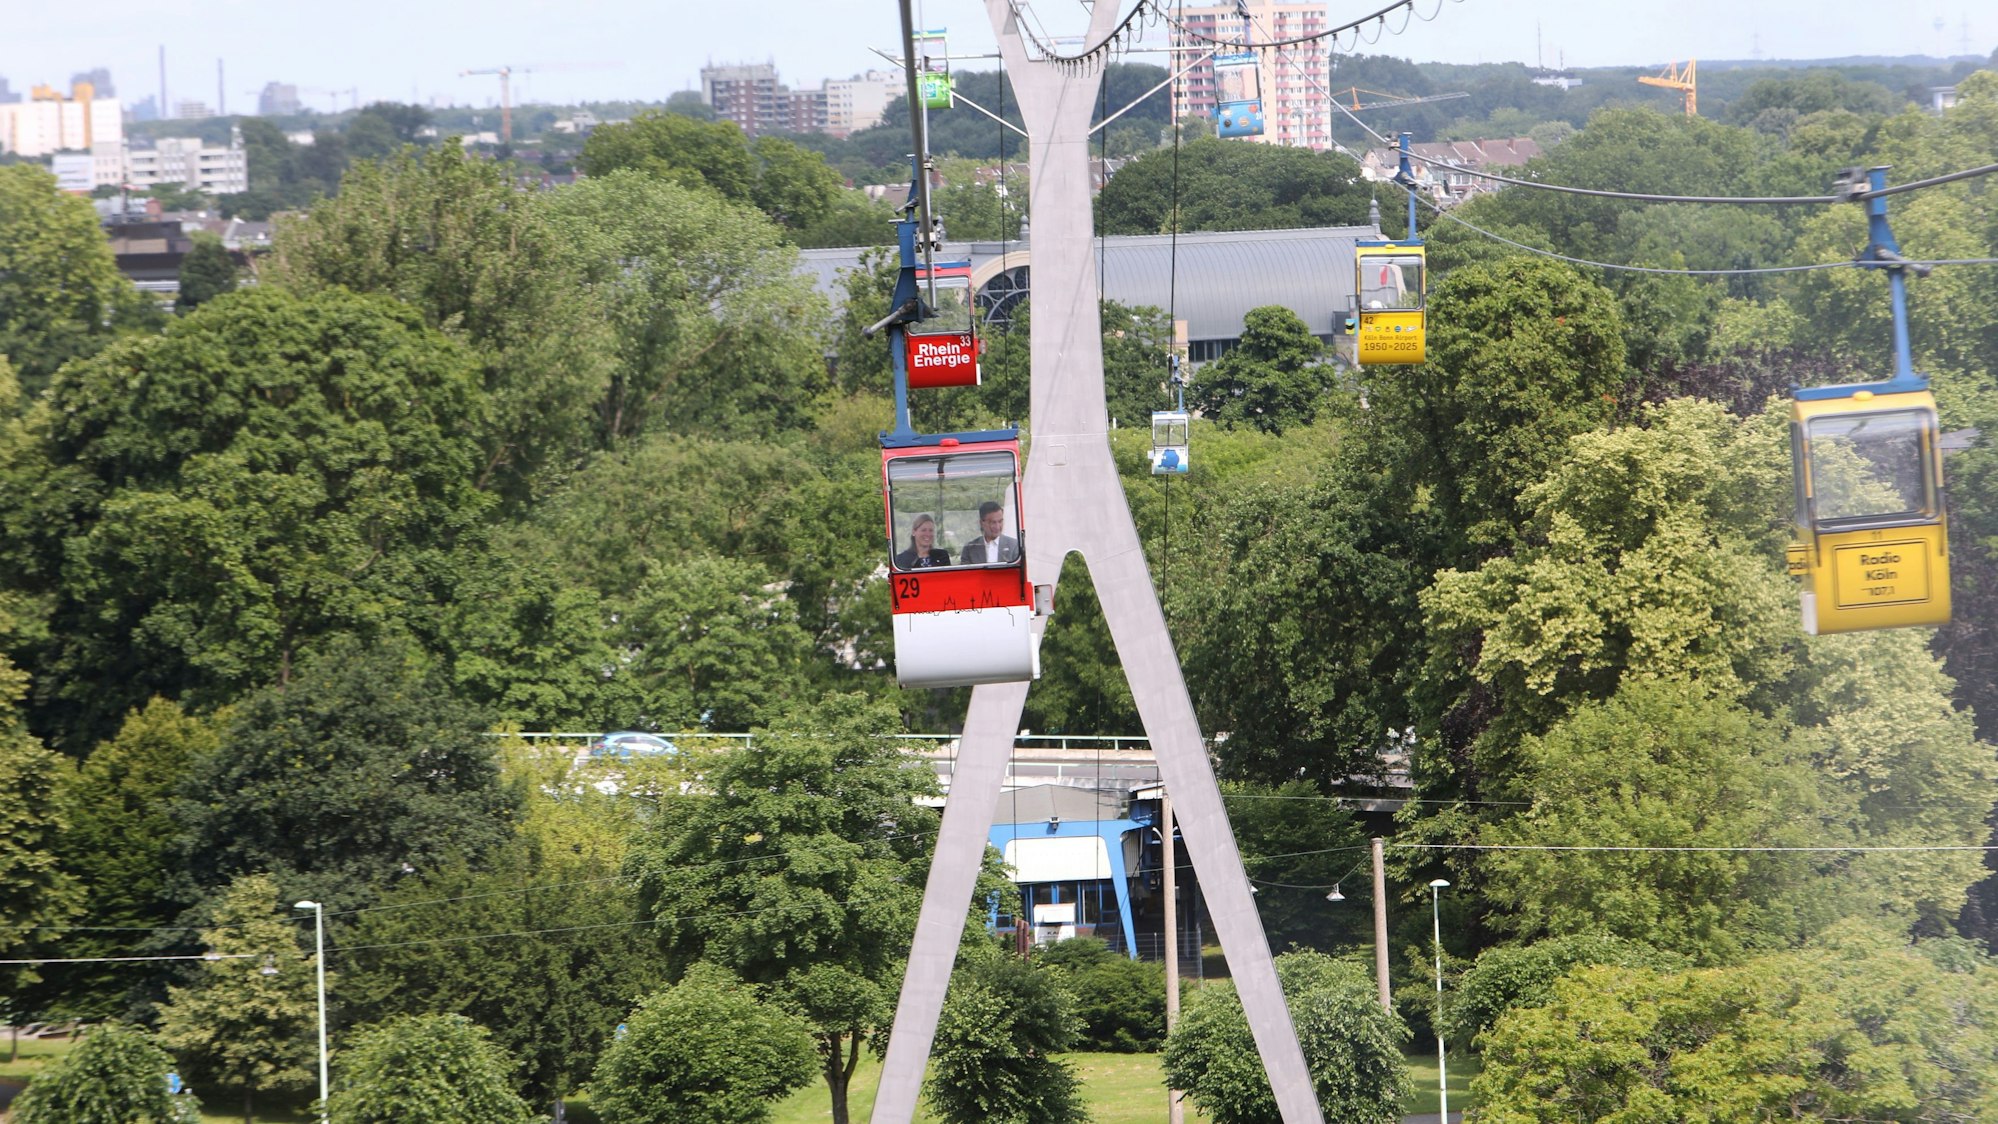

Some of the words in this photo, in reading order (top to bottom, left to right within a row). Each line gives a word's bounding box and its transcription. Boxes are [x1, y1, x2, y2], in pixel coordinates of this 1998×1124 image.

[1364, 316, 1374, 325] 42
[960, 336, 971, 346] 33
[919, 343, 960, 355] Rhein
[914, 354, 970, 367] Energie
[1860, 552, 1901, 565] Radio
[1865, 568, 1899, 581] Köln
[899, 577, 920, 599] 29
